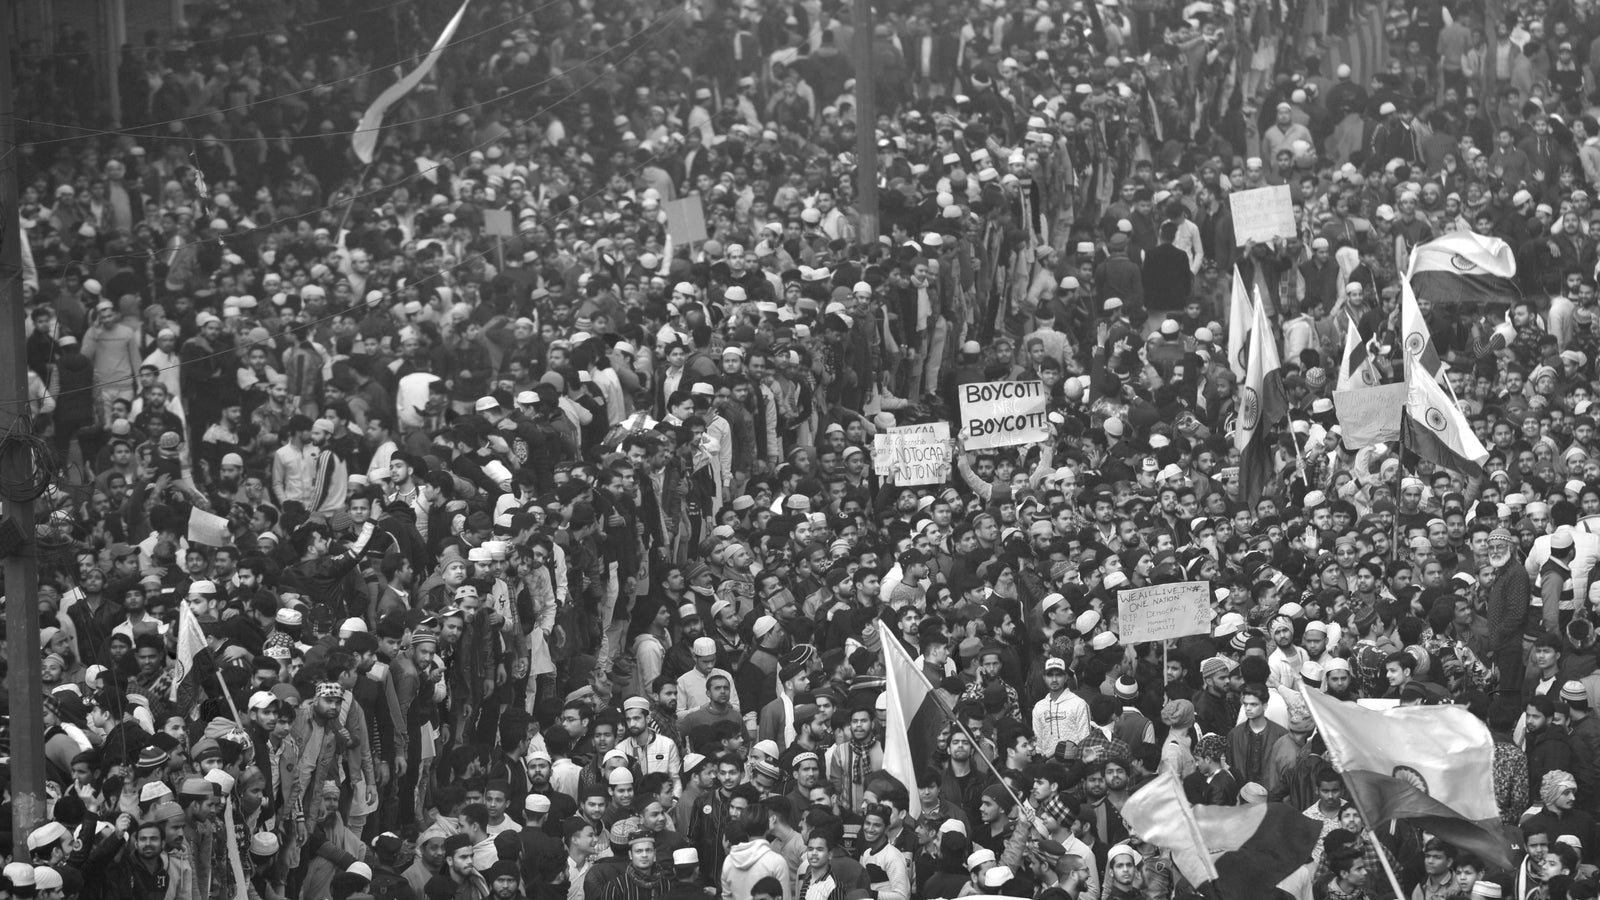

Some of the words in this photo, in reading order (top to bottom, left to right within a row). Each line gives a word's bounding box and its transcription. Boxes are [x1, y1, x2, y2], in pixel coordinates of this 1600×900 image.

[966, 382, 1041, 403] BOYCOTT
[969, 412, 1045, 437] BOYCOTT
[912, 464, 925, 479] TO
[1129, 600, 1149, 612] ONE
